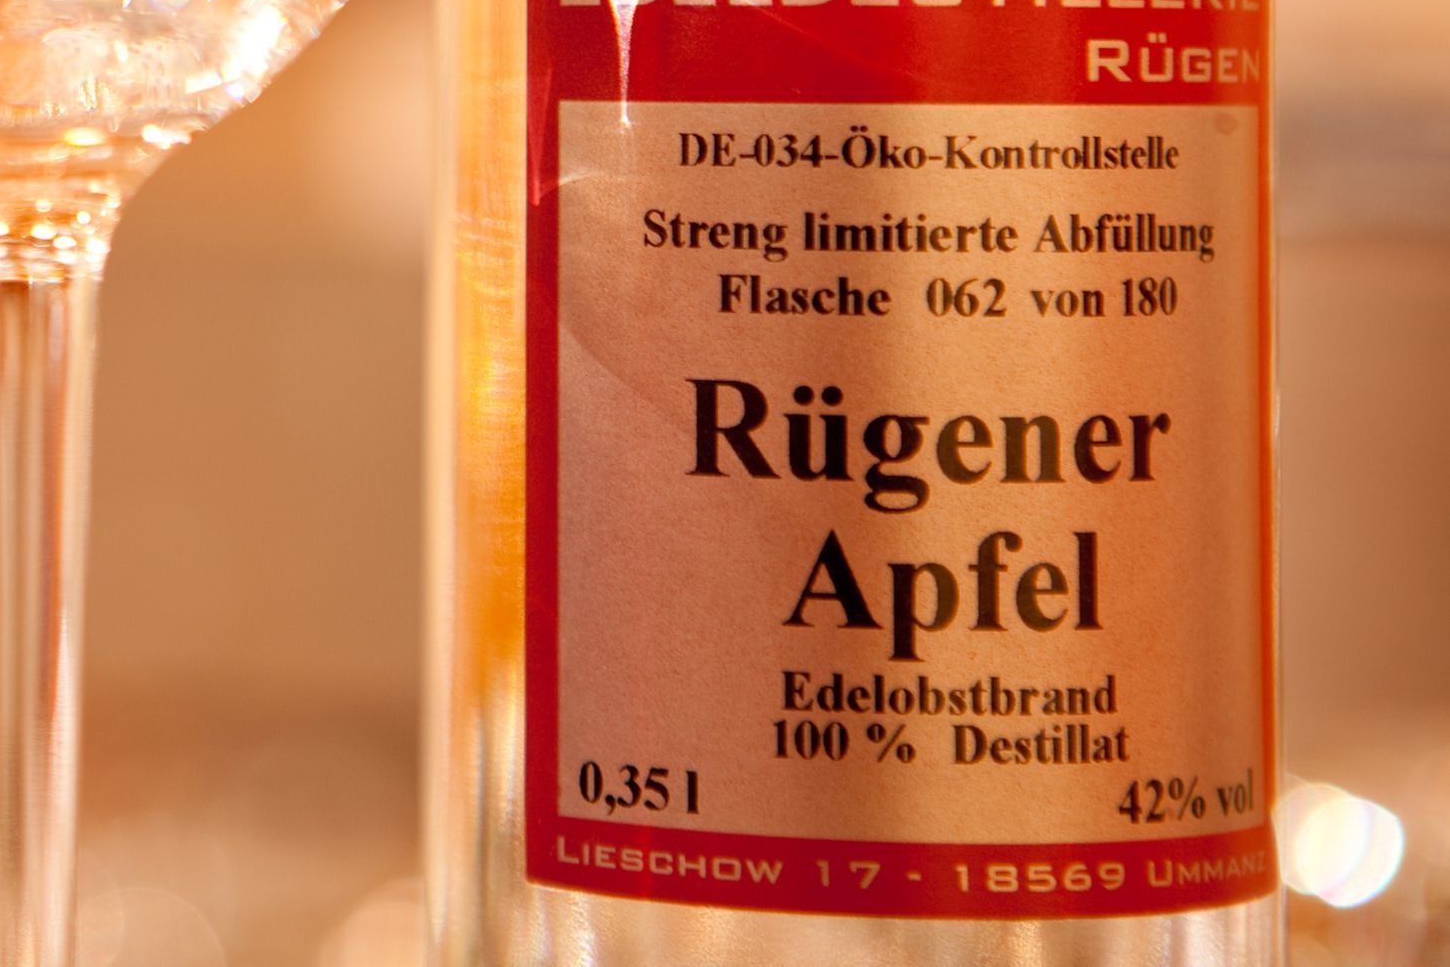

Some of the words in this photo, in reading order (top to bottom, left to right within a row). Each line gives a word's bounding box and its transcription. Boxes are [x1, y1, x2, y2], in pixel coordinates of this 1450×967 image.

[1087, 32, 1260, 83] RÜGEN
[679, 125, 1180, 171] DE-034-Öko-Kontrollstelle
[643, 209, 789, 263] Streng
[804, 211, 1018, 254] limitierte
[1034, 213, 1216, 263] Abfüllung
[718, 274, 891, 317] Flasche
[926, 278, 1007, 318] 062
[1030, 288, 1106, 318] von
[1122, 277, 1178, 318] 180
[685, 378, 1172, 515] Rügener
[782, 530, 1104, 662] Apfel
[781, 670, 1119, 716] Edelobstbrand
[773, 719, 849, 761] 100
[865, 723, 916, 764] %
[951, 723, 1130, 765] Destillat
[578, 761, 671, 816] 0,35
[1118, 774, 1206, 824] 42%
[1216, 767, 1254, 817] vol
[556, 836, 783, 885] LIESCHOW
[815, 860, 880, 891] 17
[955, 862, 1126, 894] 18569
[1147, 851, 1267, 887] UMMANZ
